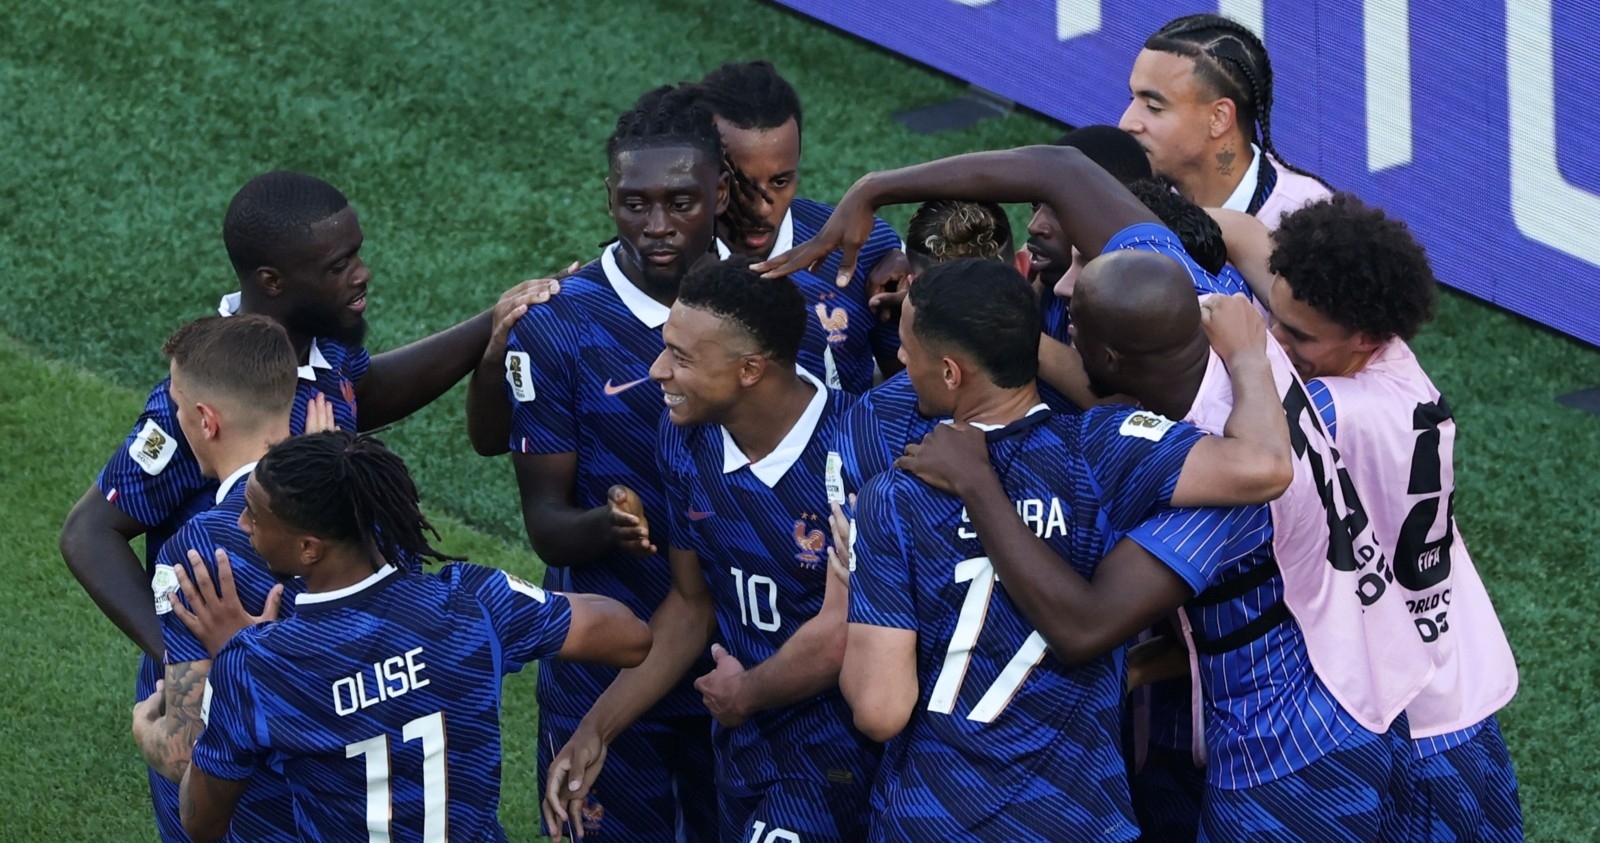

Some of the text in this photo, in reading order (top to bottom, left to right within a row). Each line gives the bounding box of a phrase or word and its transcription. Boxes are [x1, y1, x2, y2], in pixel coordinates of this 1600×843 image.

[958, 497, 1067, 539] SBA
[1418, 546, 1440, 572] FIFA
[730, 566, 781, 632] 10
[1405, 594, 1440, 614] ORLD
[332, 646, 430, 717] OLISE
[345, 710, 450, 843] 11
